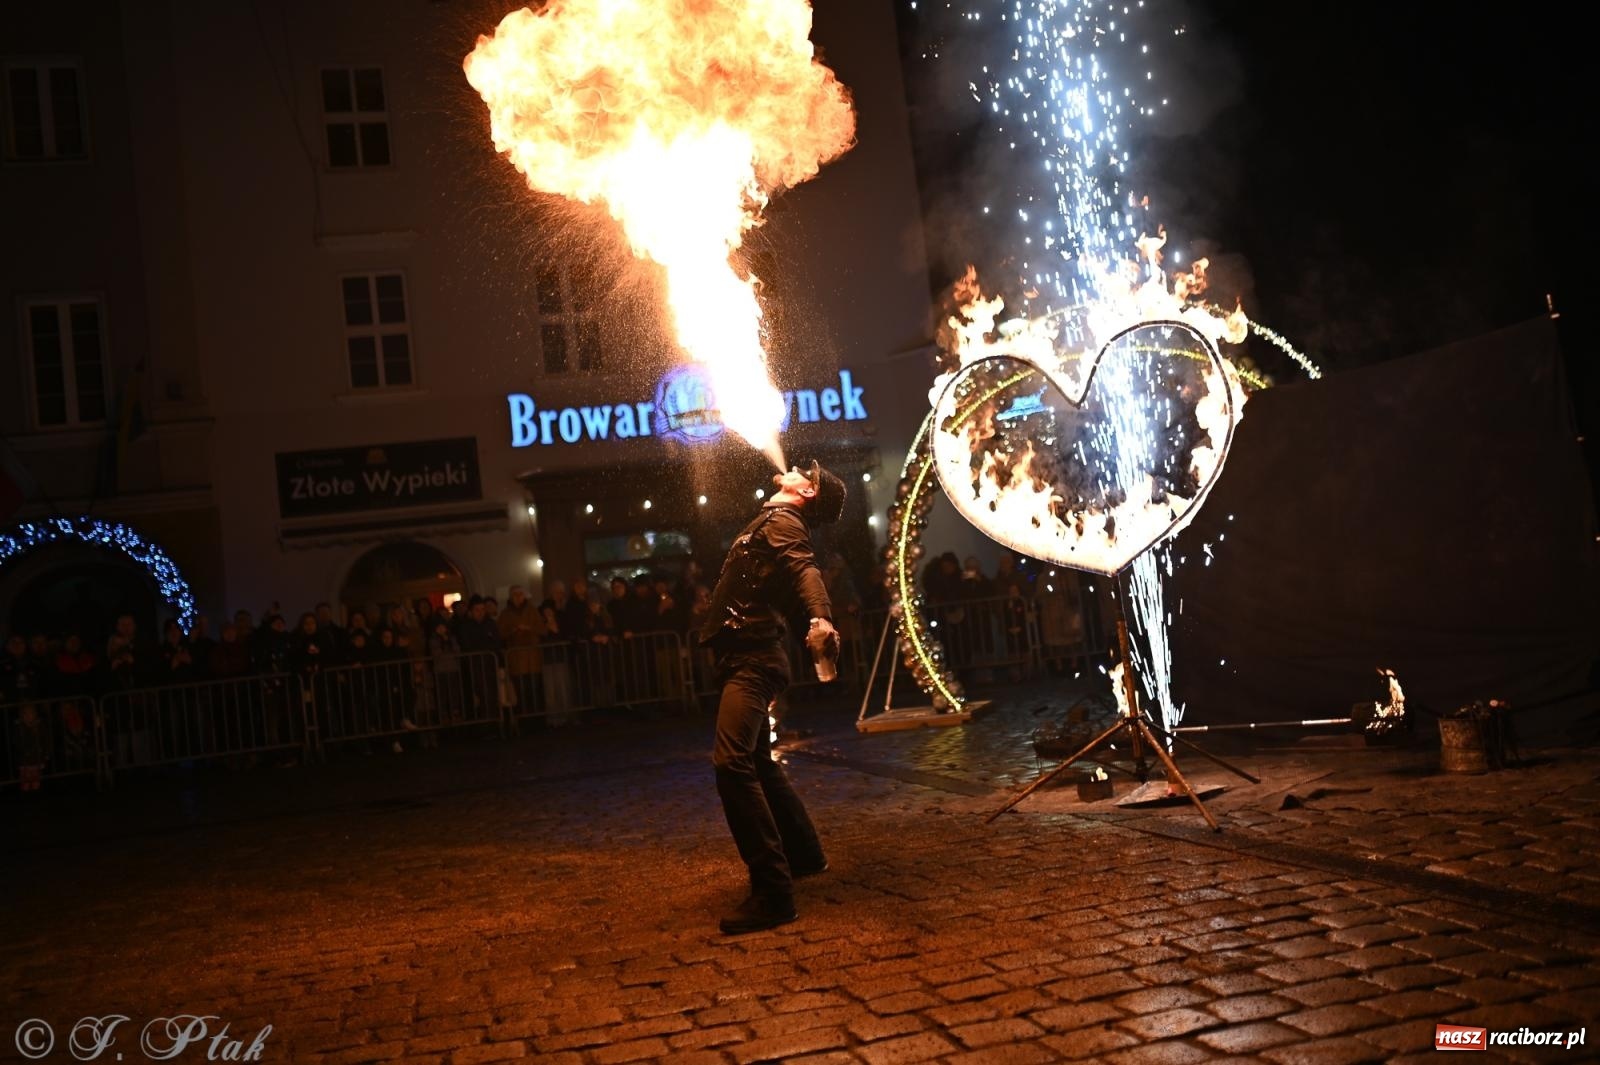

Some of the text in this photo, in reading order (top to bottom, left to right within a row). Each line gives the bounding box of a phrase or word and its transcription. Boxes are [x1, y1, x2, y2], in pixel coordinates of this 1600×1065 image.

[508, 393, 655, 448] Browar
[290, 474, 355, 500] Złote
[362, 462, 467, 495] Wypieki
